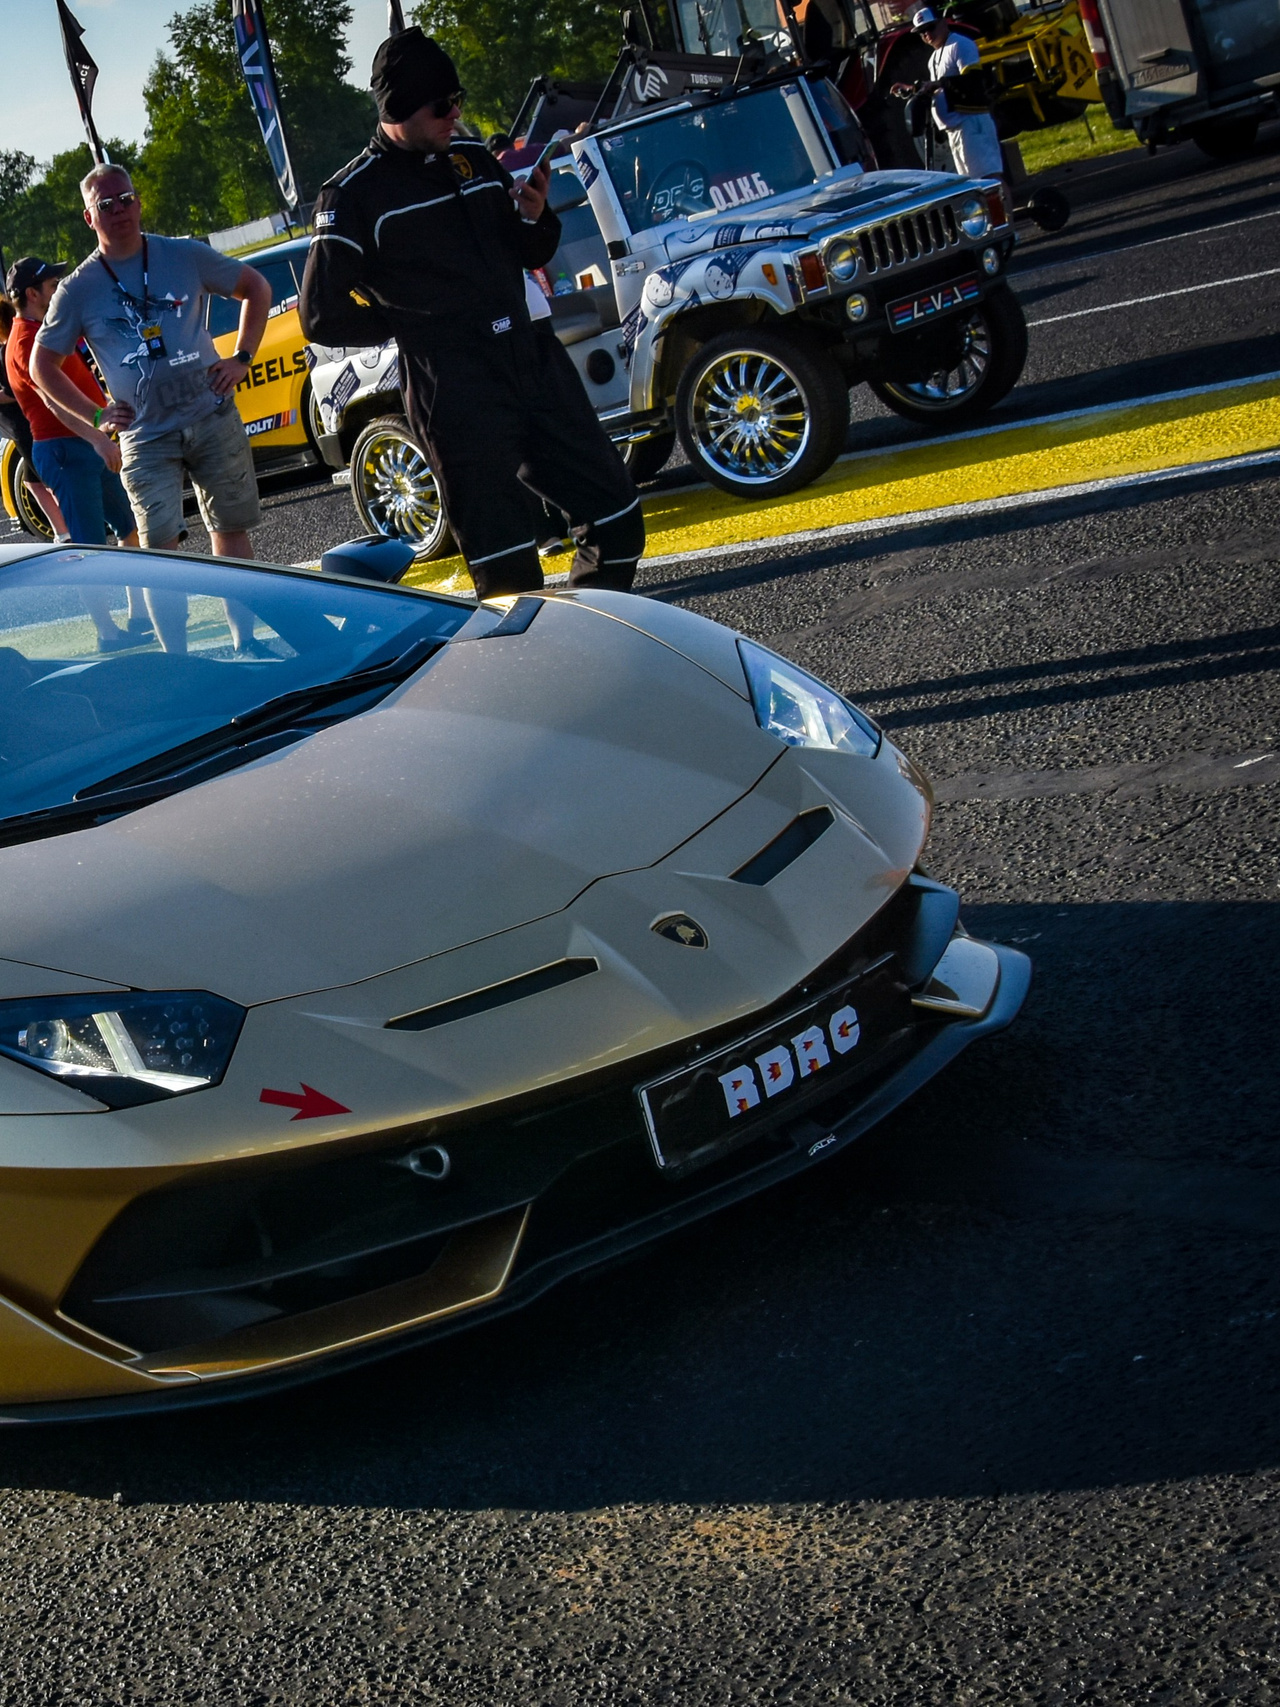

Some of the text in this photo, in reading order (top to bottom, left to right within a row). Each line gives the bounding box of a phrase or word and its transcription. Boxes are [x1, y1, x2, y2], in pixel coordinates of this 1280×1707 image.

[315, 213, 335, 225] OMP
[492, 318, 511, 332] OMP
[718, 1005, 861, 1118] RDRC
